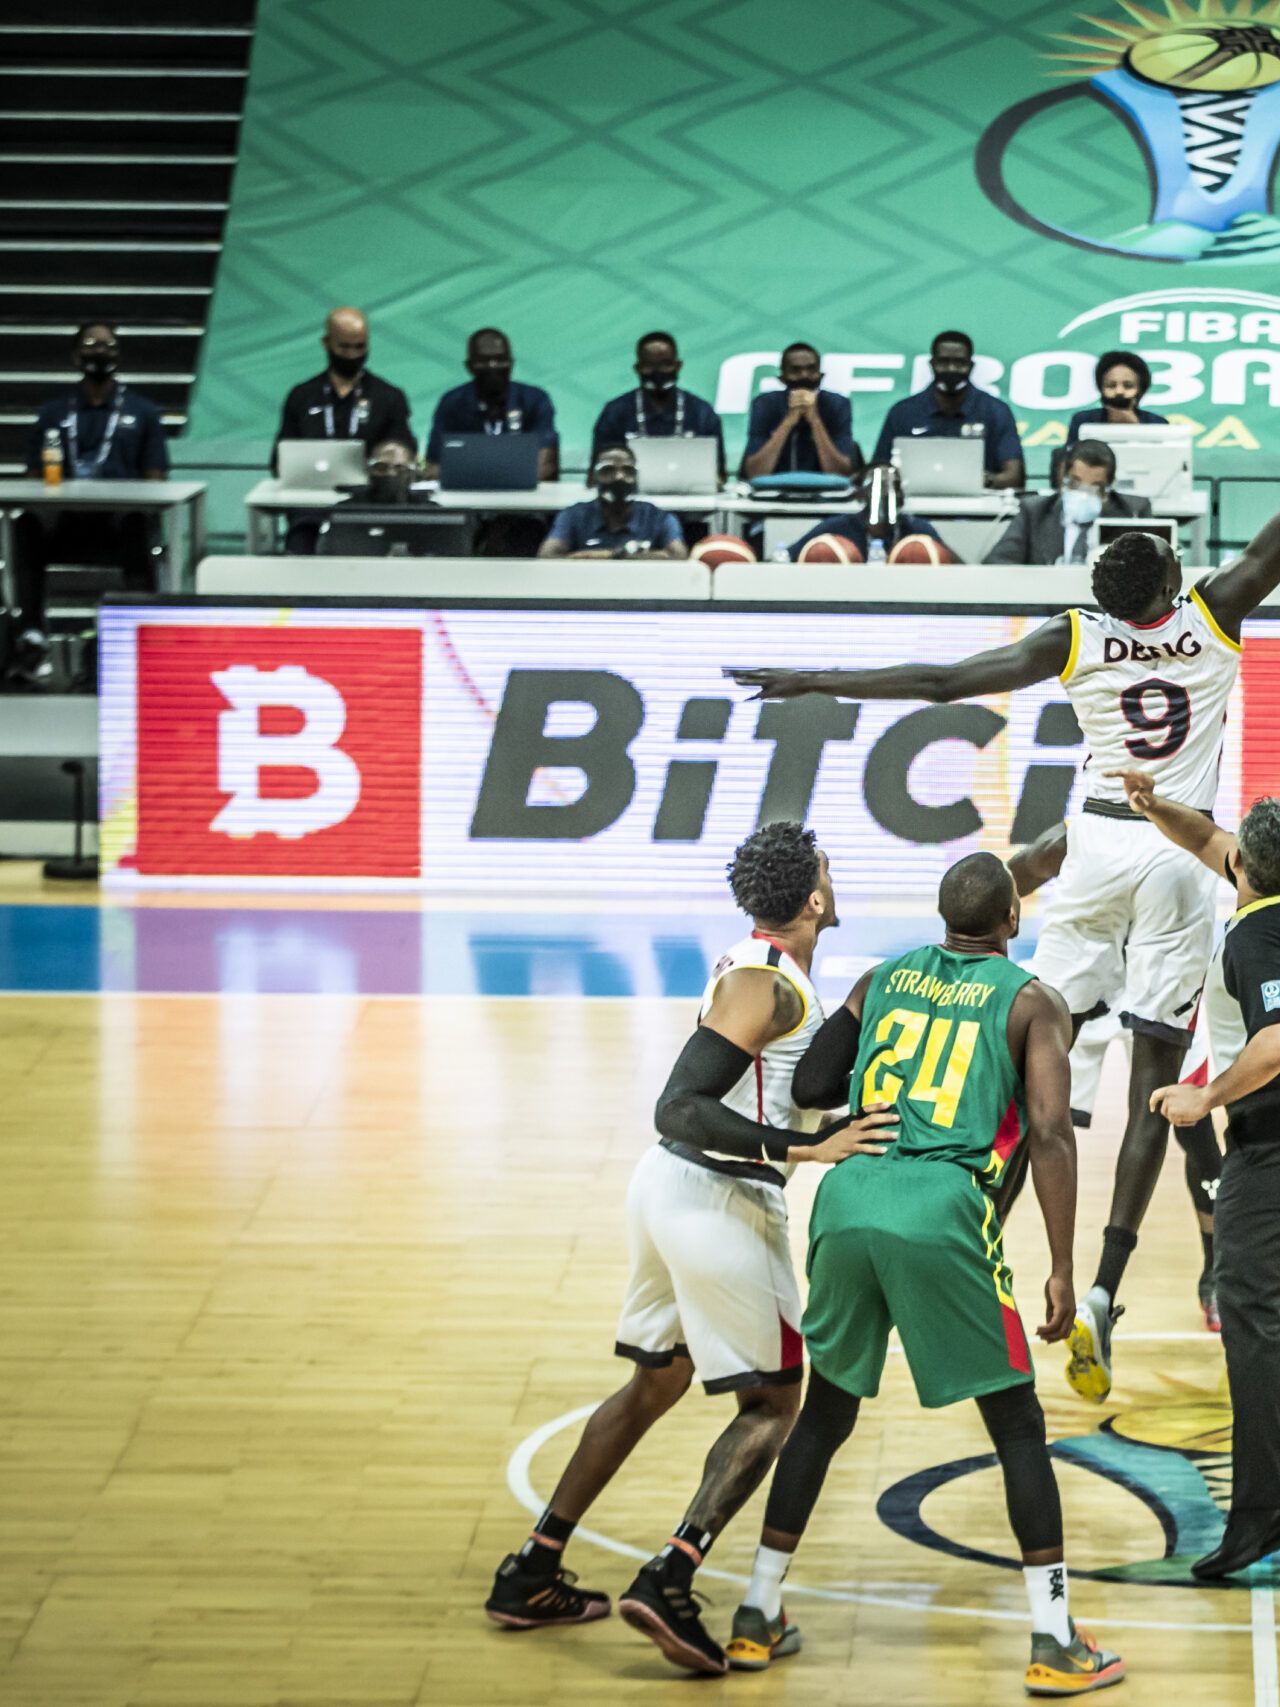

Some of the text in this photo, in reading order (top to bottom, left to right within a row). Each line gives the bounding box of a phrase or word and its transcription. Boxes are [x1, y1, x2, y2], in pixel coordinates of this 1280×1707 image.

[1120, 677, 1192, 761] 9
[861, 1007, 981, 1129] 24
[1047, 1567, 1066, 1602] PEAK
